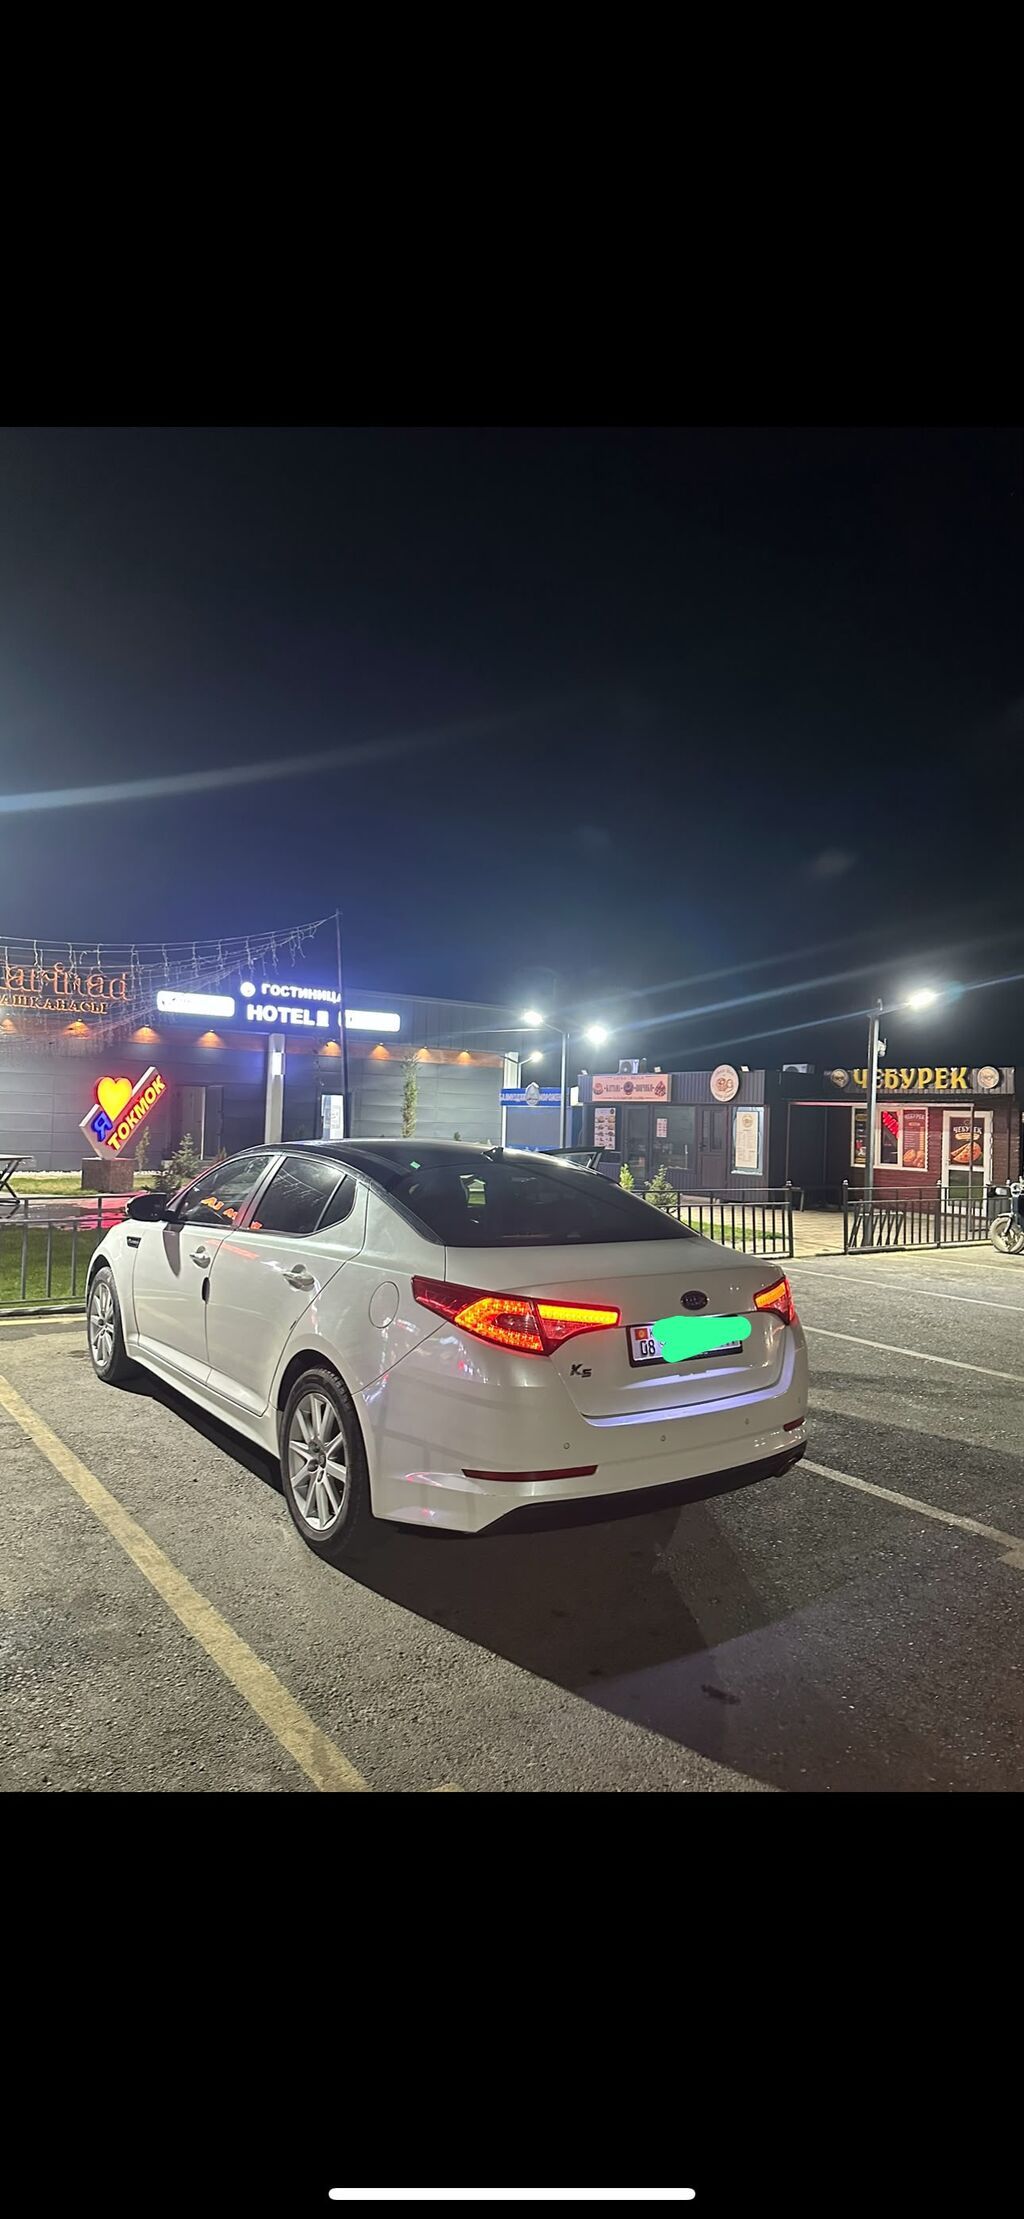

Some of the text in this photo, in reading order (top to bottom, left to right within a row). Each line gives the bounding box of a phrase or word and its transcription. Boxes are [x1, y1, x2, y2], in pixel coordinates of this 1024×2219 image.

[0, 962, 132, 1002] arinad
[247, 1004, 315, 1026] HOTEL
[91, 1110, 113, 1142] Я
[107, 1074, 166, 1150] ТОКМОК
[640, 1339, 656, 1356] 08
